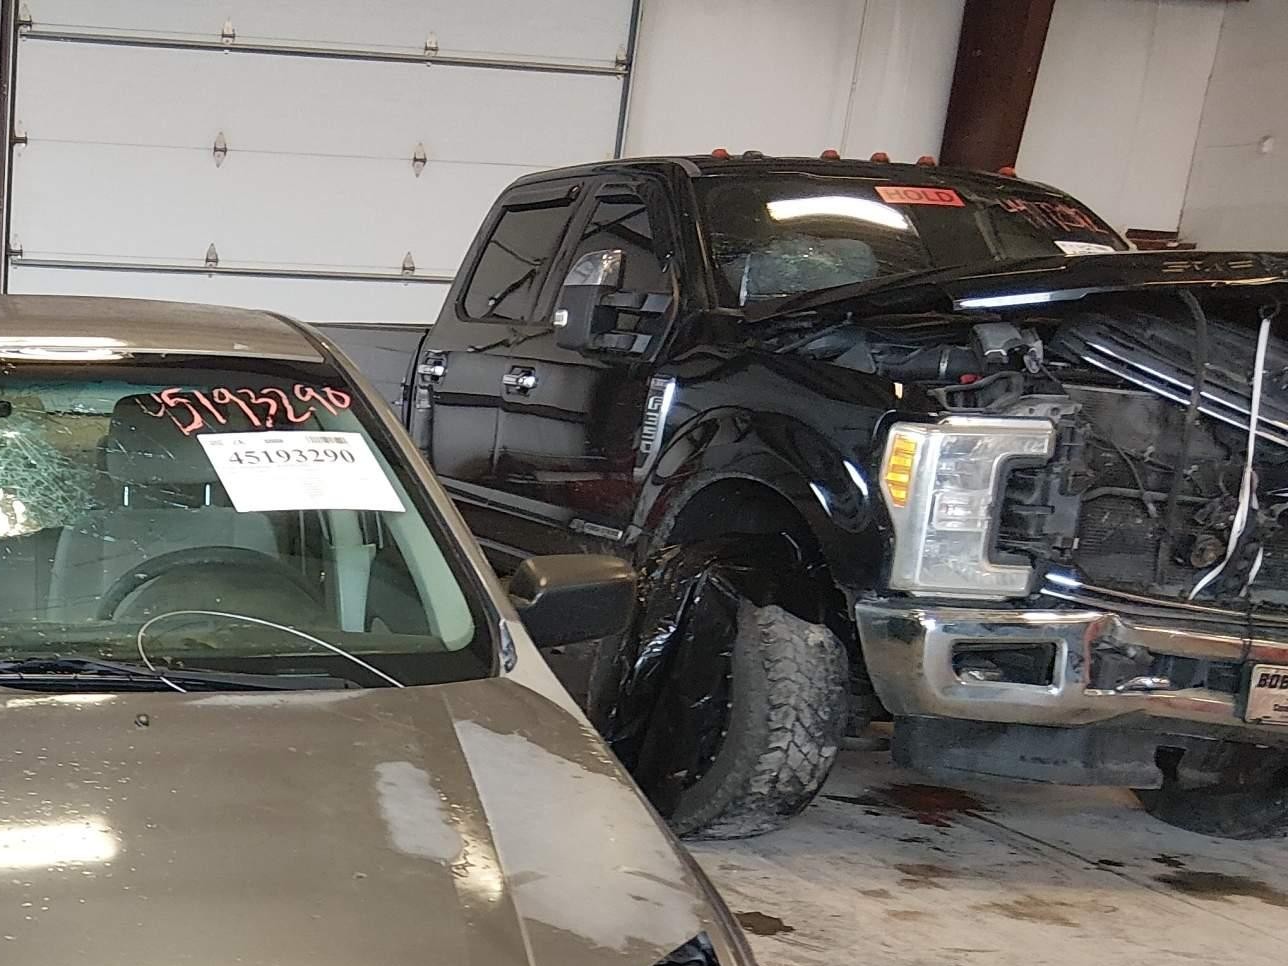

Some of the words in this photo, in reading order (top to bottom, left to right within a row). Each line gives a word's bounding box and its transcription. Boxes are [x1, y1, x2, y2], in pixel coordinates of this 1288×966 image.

[885, 189, 954, 203] HOLD
[136, 384, 351, 436] 45193290
[229, 448, 356, 465] 45193290
